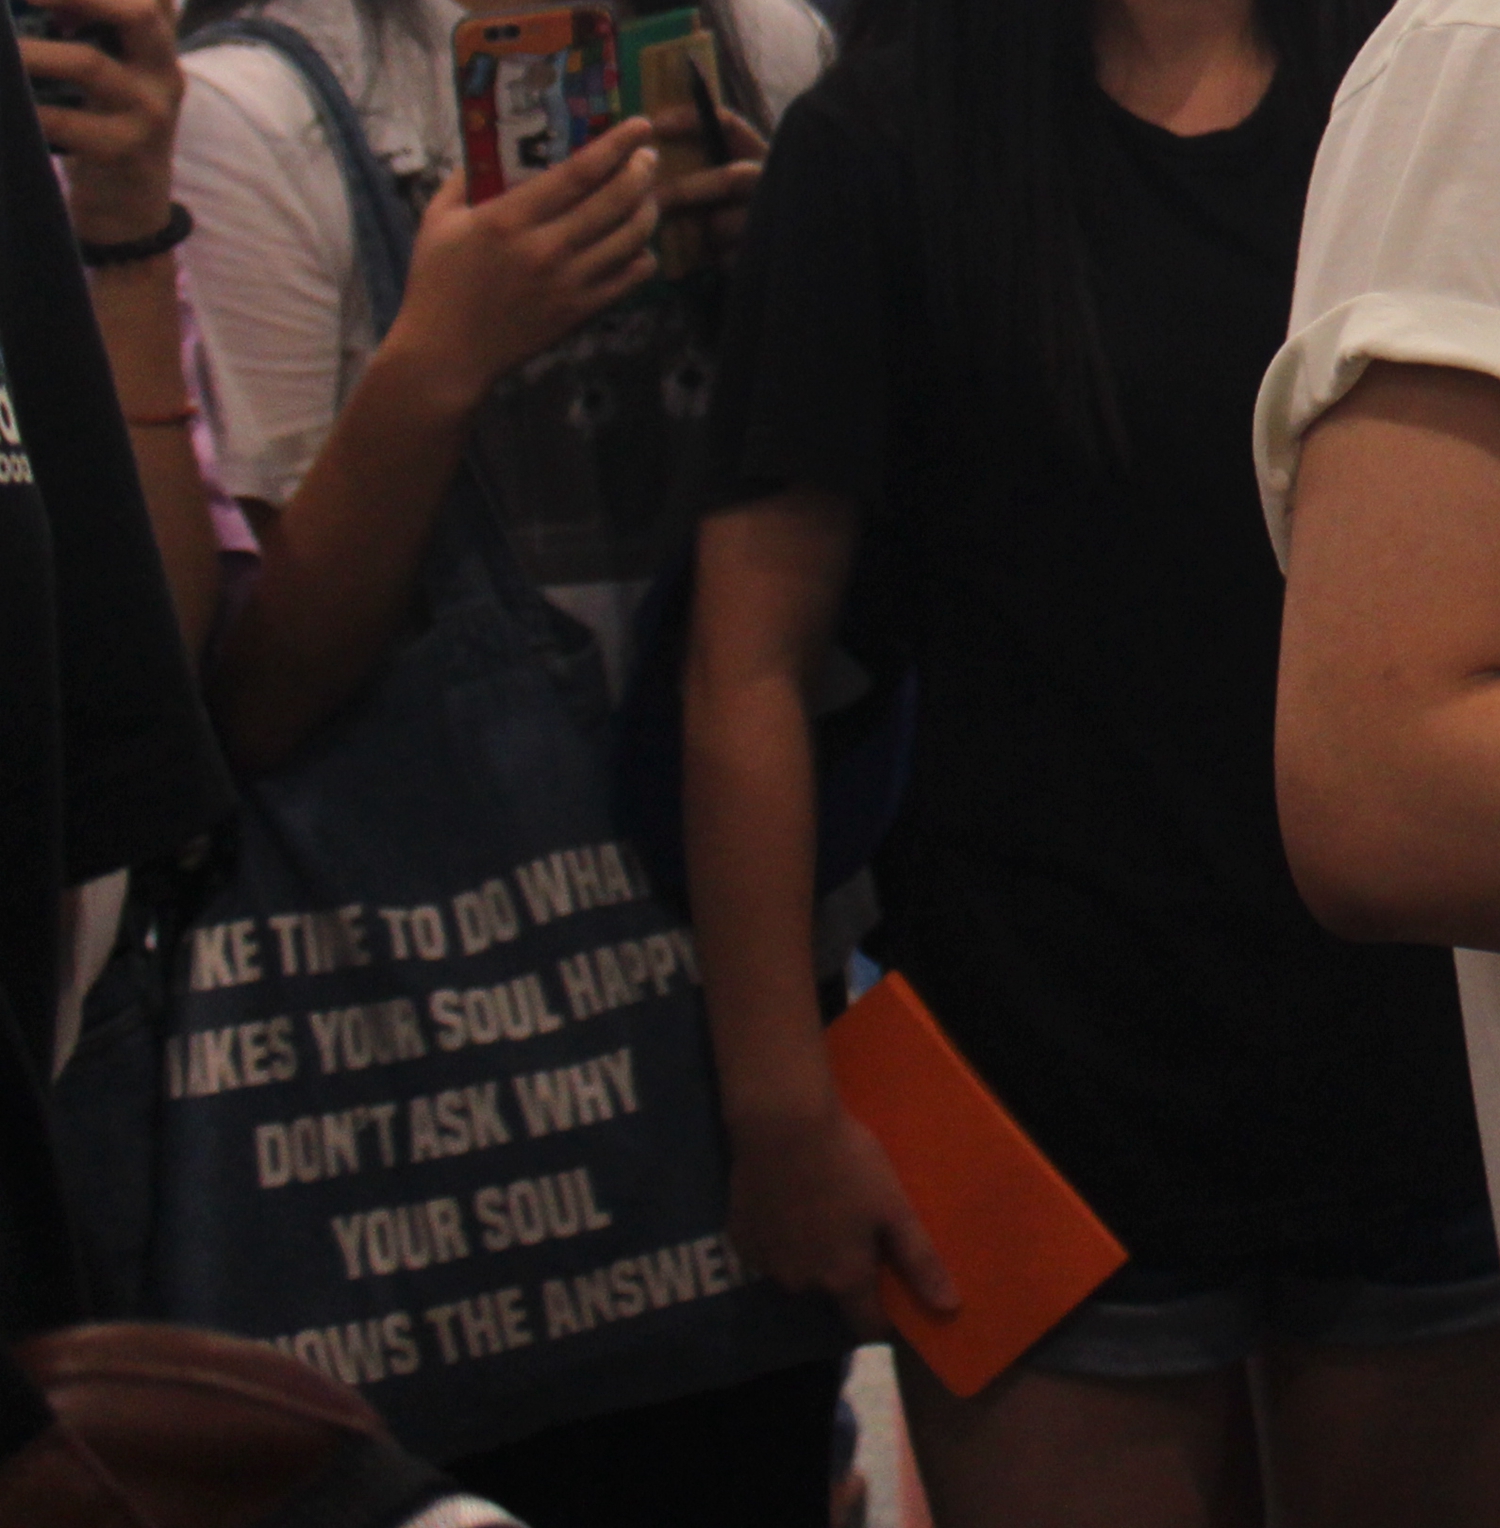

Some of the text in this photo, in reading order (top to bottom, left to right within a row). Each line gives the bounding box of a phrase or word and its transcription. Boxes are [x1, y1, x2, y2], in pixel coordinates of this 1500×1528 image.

[379, 904, 447, 962] TO
[452, 878, 519, 957] DO
[429, 973, 564, 1052] SOUL
[255, 1047, 641, 1189] DON'T ASK WHY
[331, 1167, 613, 1281] YOUR SOUL
[262, 1310, 420, 1386] OWS
[425, 1288, 534, 1366] THE
